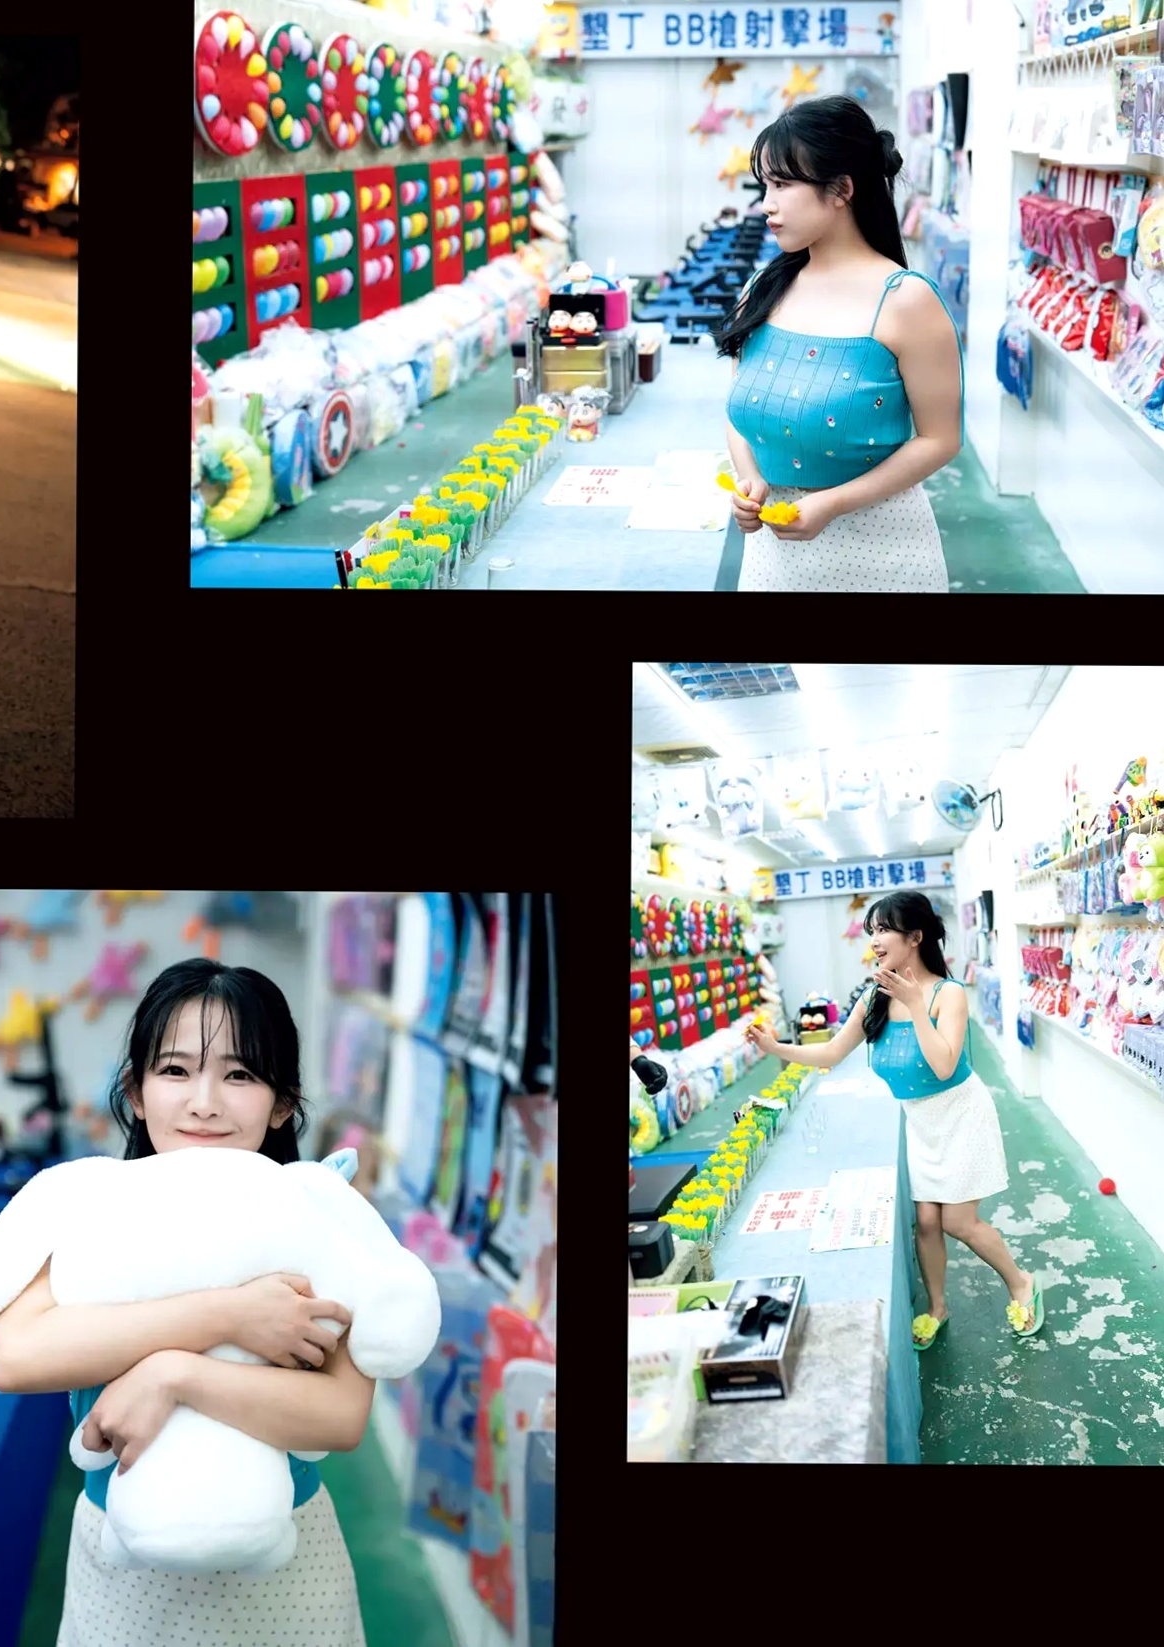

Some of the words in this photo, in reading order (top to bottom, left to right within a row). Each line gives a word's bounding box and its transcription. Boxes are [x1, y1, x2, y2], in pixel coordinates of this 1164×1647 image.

[582, 12, 644, 50] 墾丁
[664, 8, 847, 49] BB槍射擊場
[775, 870, 811, 896] 墾丁
[822, 860, 926, 890] BB槍射擊場
